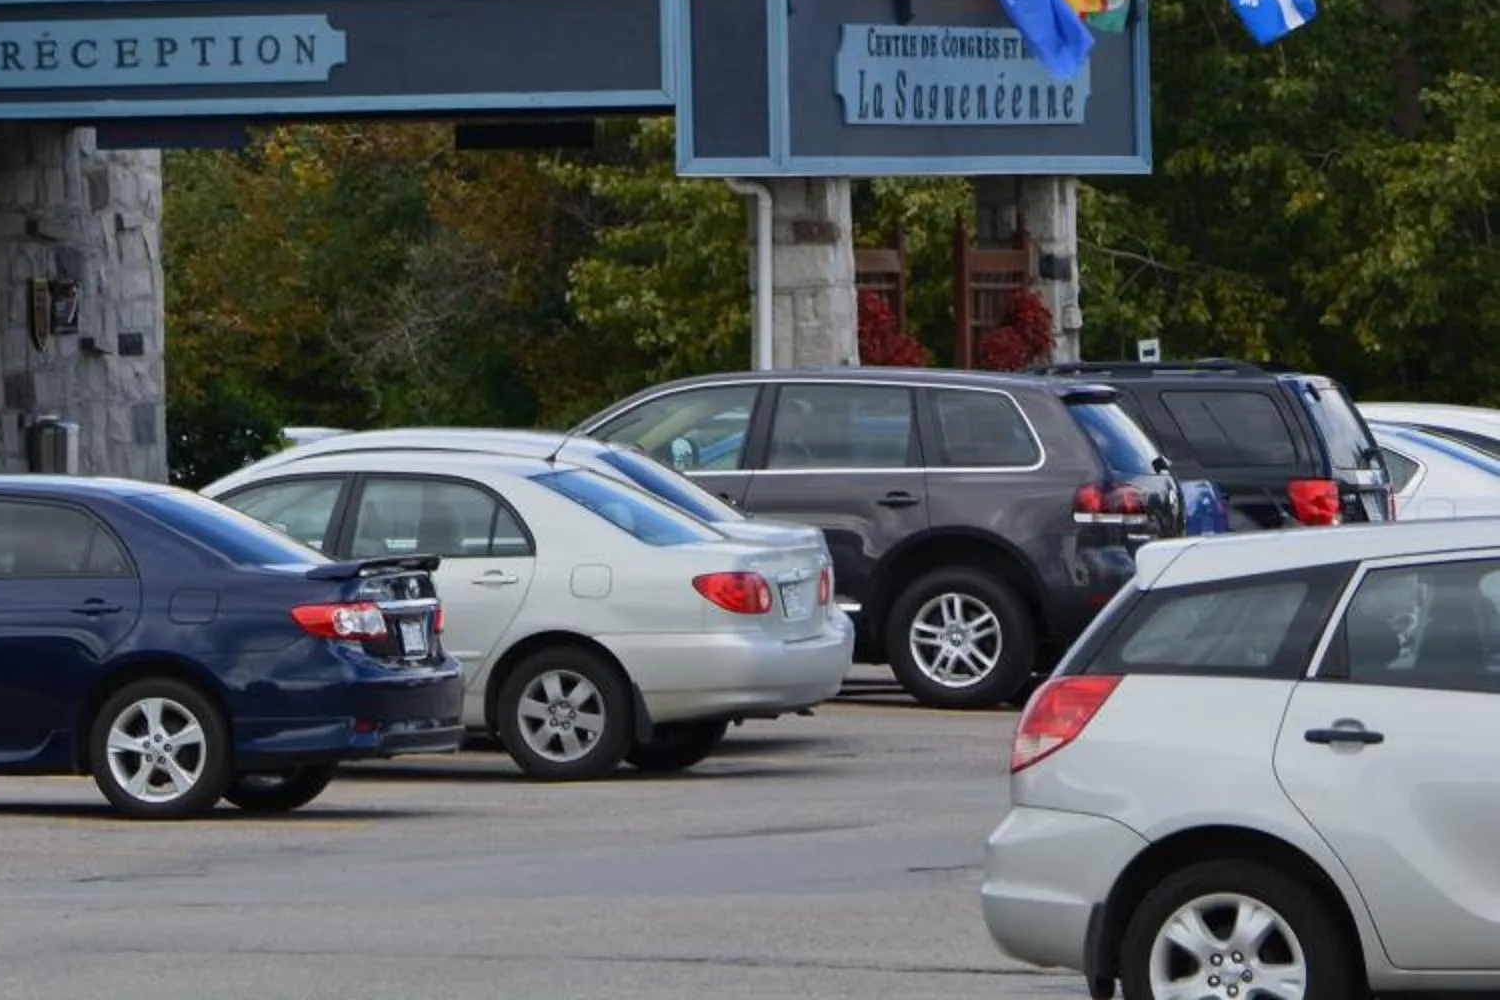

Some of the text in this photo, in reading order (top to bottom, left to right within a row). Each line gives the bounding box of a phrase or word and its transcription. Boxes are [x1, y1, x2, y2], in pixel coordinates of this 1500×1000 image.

[0, 31, 318, 71] RÉCEPTION
[867, 28, 918, 57] CENTRE
[921, 35, 939, 57] DE
[942, 29, 1000, 59] CONGRÈS
[1002, 37, 1021, 59] ET
[857, 69, 1075, 120] La Saguenéenne
